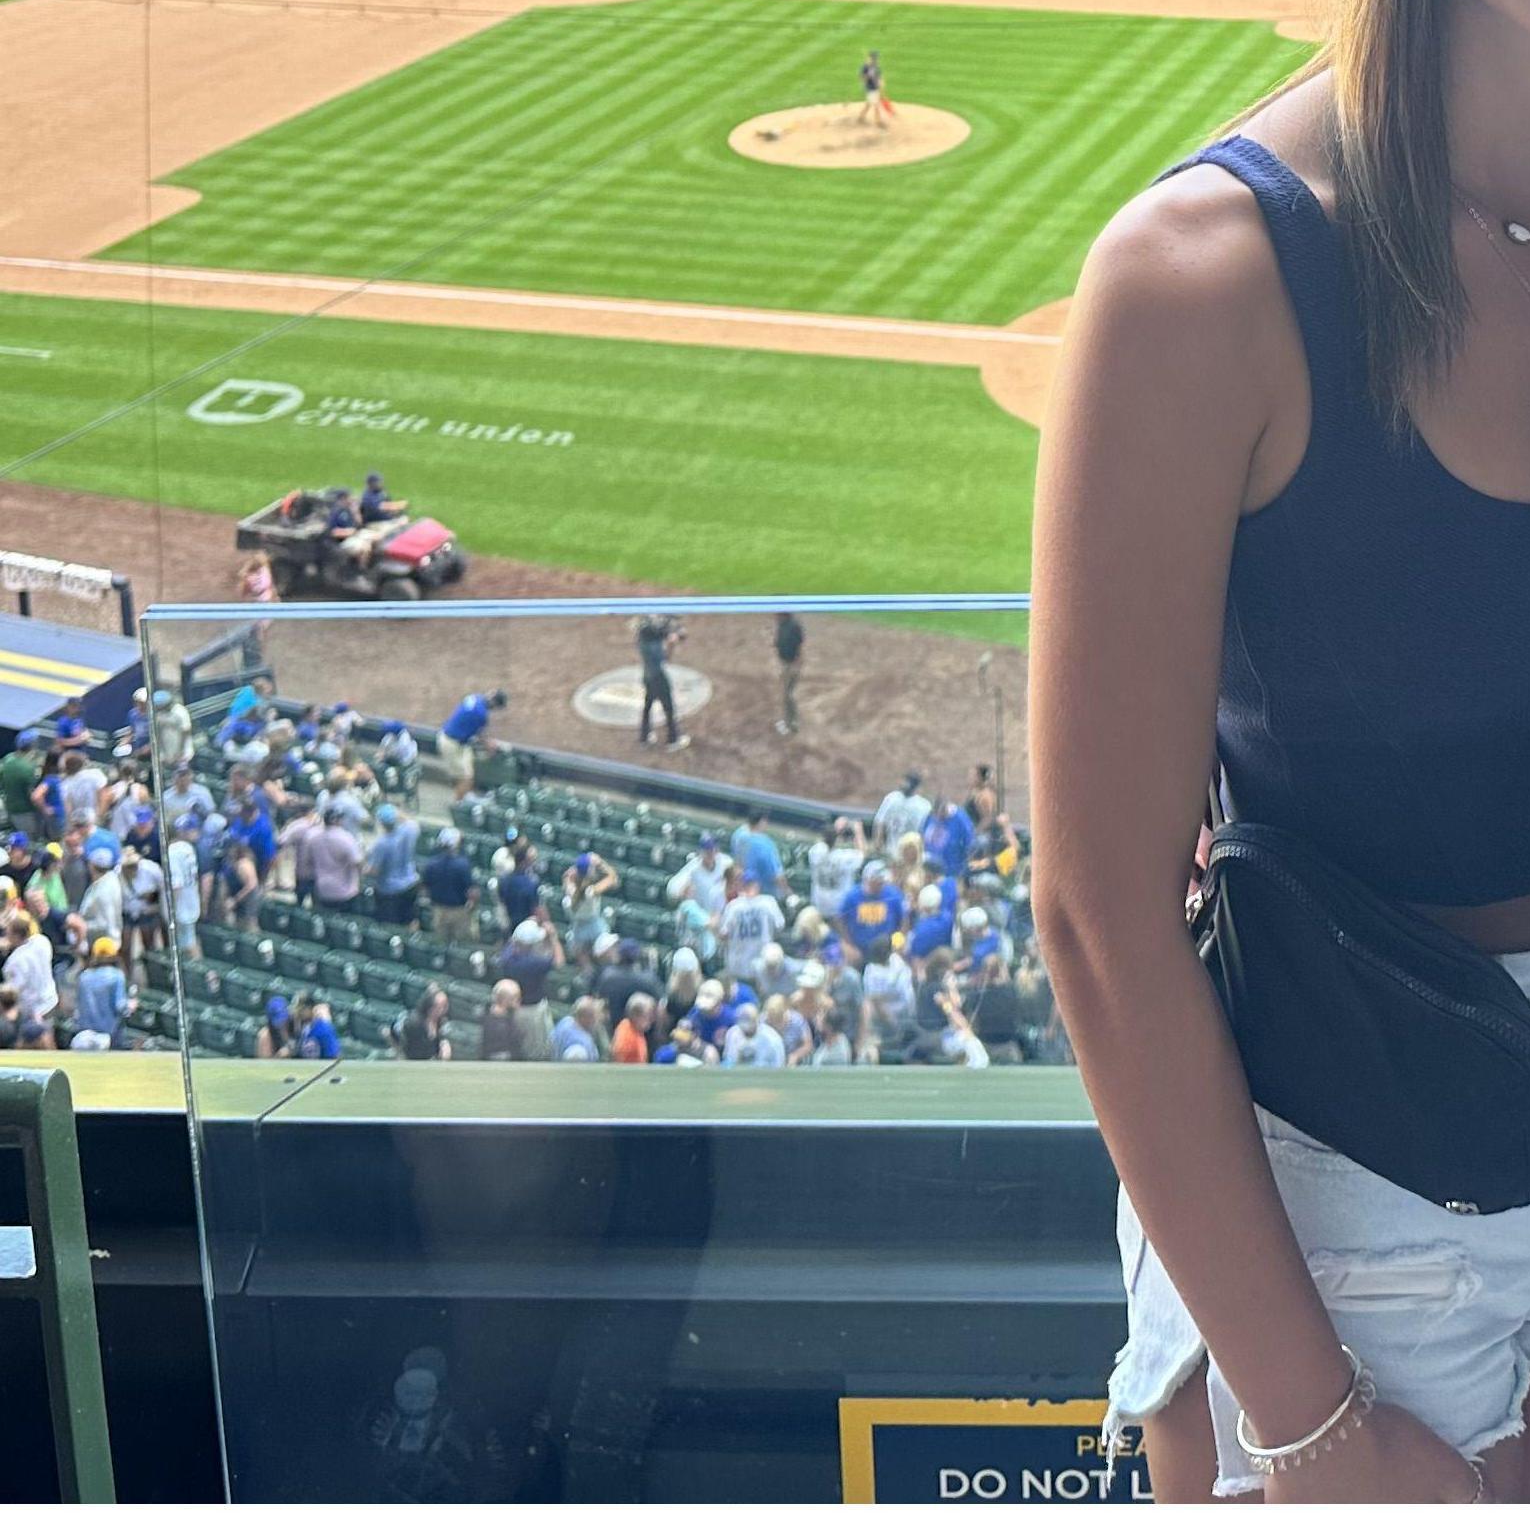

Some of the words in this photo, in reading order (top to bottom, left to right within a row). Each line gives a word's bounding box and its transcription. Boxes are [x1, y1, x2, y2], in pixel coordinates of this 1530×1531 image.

[295, 411, 430, 432] credit
[1077, 1435, 1148, 1456] PLEA
[939, 1468, 1007, 1499] DO
[1022, 1468, 1116, 1500] NOT
[1132, 1470, 1153, 1499] L
